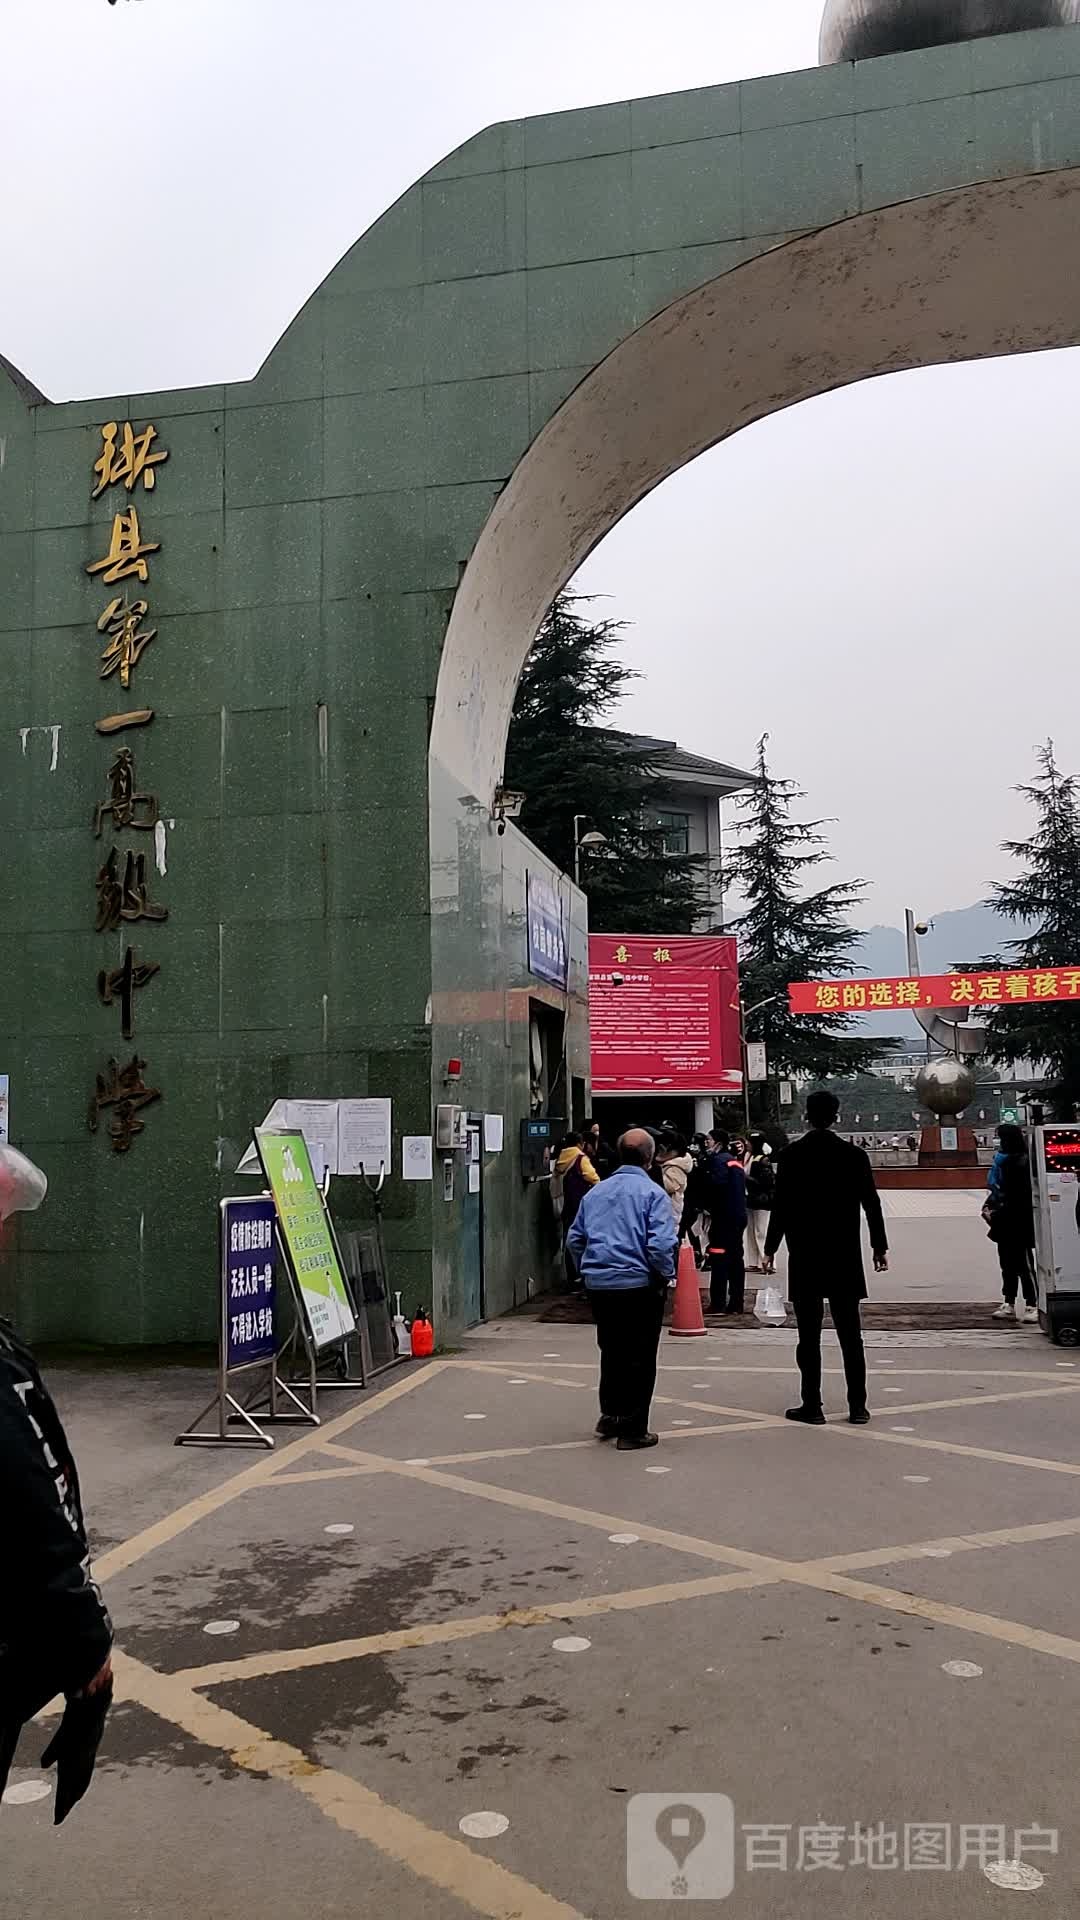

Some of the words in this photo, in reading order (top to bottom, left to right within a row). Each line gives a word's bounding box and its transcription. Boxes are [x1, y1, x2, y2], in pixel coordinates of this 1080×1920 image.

[816, 971, 1080, 1007] 您的选择，决定着孩子
[231, 1220, 272, 1252] 疫情防控期间
[231, 1263, 272, 1298] 无关人员一律
[231, 1307, 273, 1345] 不得进入学校
